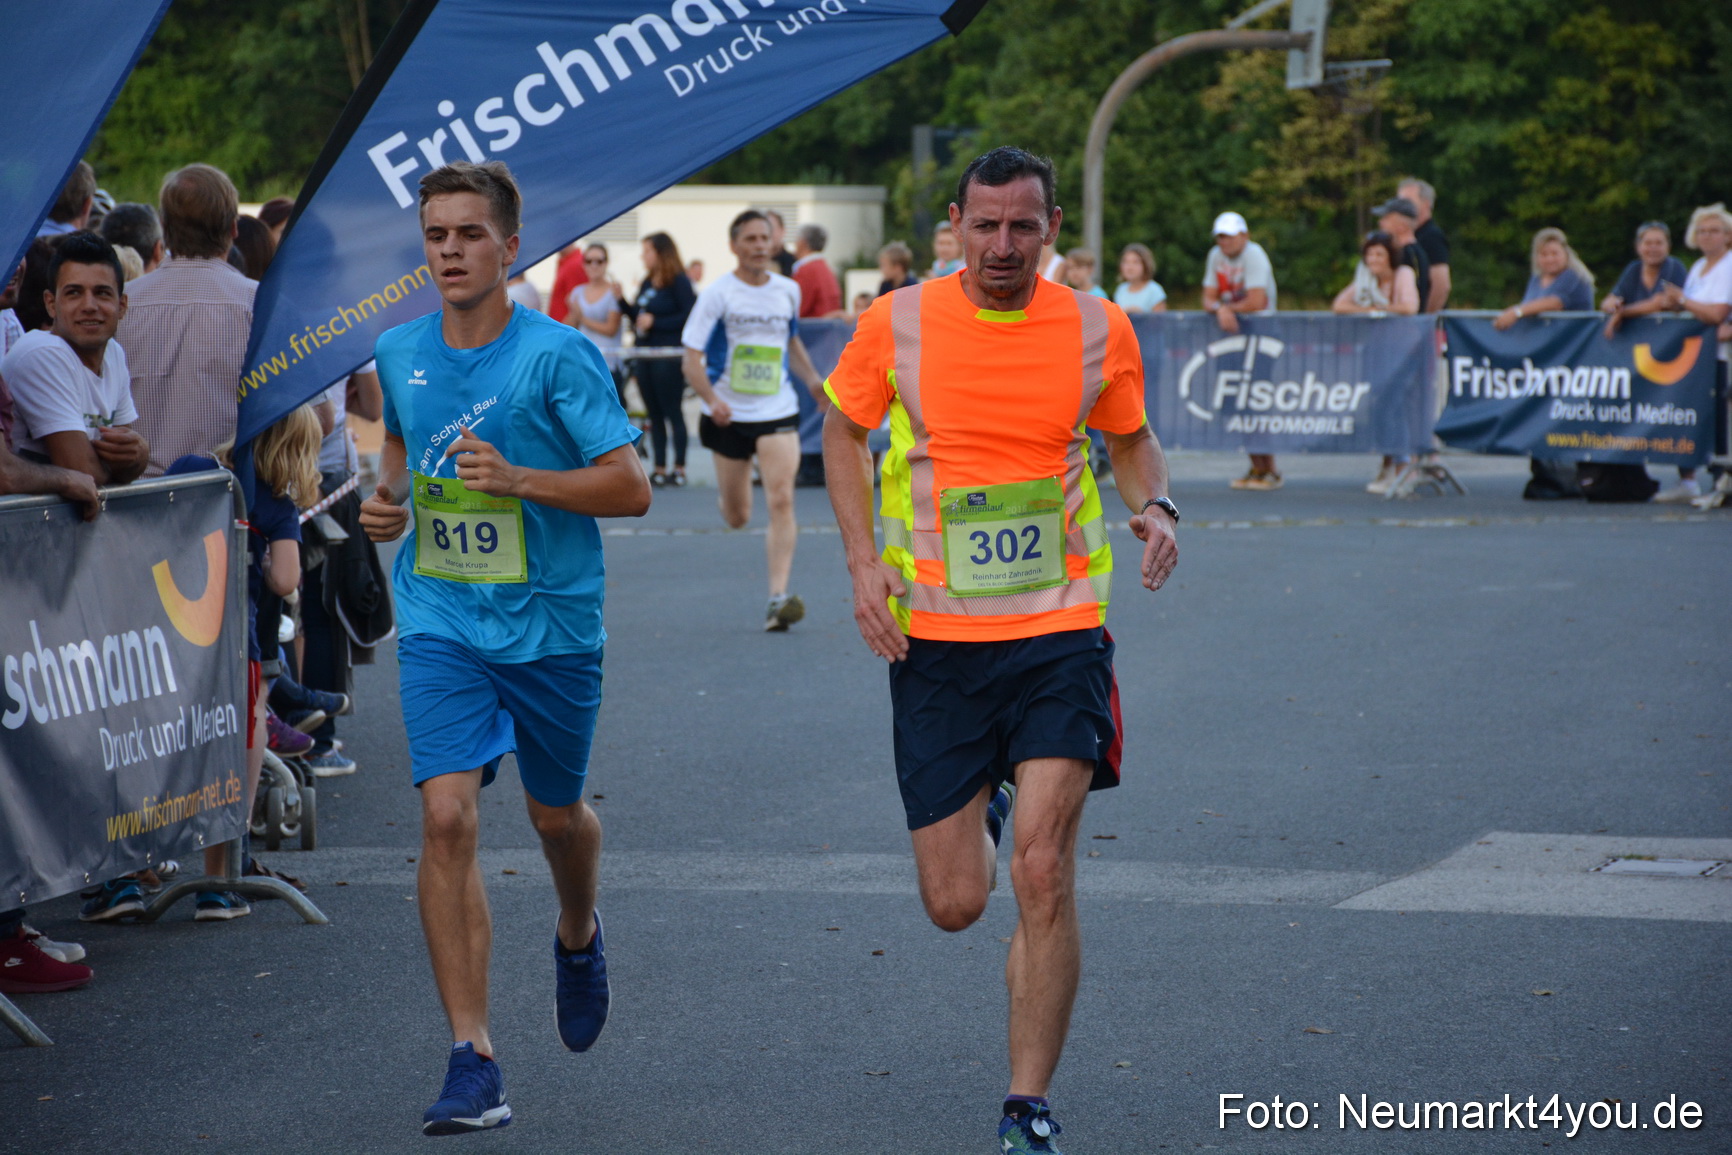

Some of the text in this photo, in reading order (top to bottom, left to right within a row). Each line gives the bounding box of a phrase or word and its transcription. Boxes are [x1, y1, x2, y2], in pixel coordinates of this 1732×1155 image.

[664, 0, 848, 97] Druck und
[1213, 371, 1371, 412] Fischer
[1453, 356, 1631, 399] Frischmann
[431, 412, 473, 447] Schick
[472, 396, 498, 416] Bau
[1227, 415, 1355, 434] AUTOMOBILE
[1551, 400, 1698, 427] Druck und Medien
[1546, 432, 1696, 455] www.frischmann-net.de
[960, 503, 1004, 514] firmenlauf
[432, 518, 499, 555] 819
[969, 525, 1043, 566] 302
[972, 568, 1043, 581] Reinhard Zahradnik
[1, 620, 178, 730] schmann
[99, 717, 148, 771] Druck
[149, 706, 187, 758] und
[106, 769, 242, 843] www.frischmann-net.de
